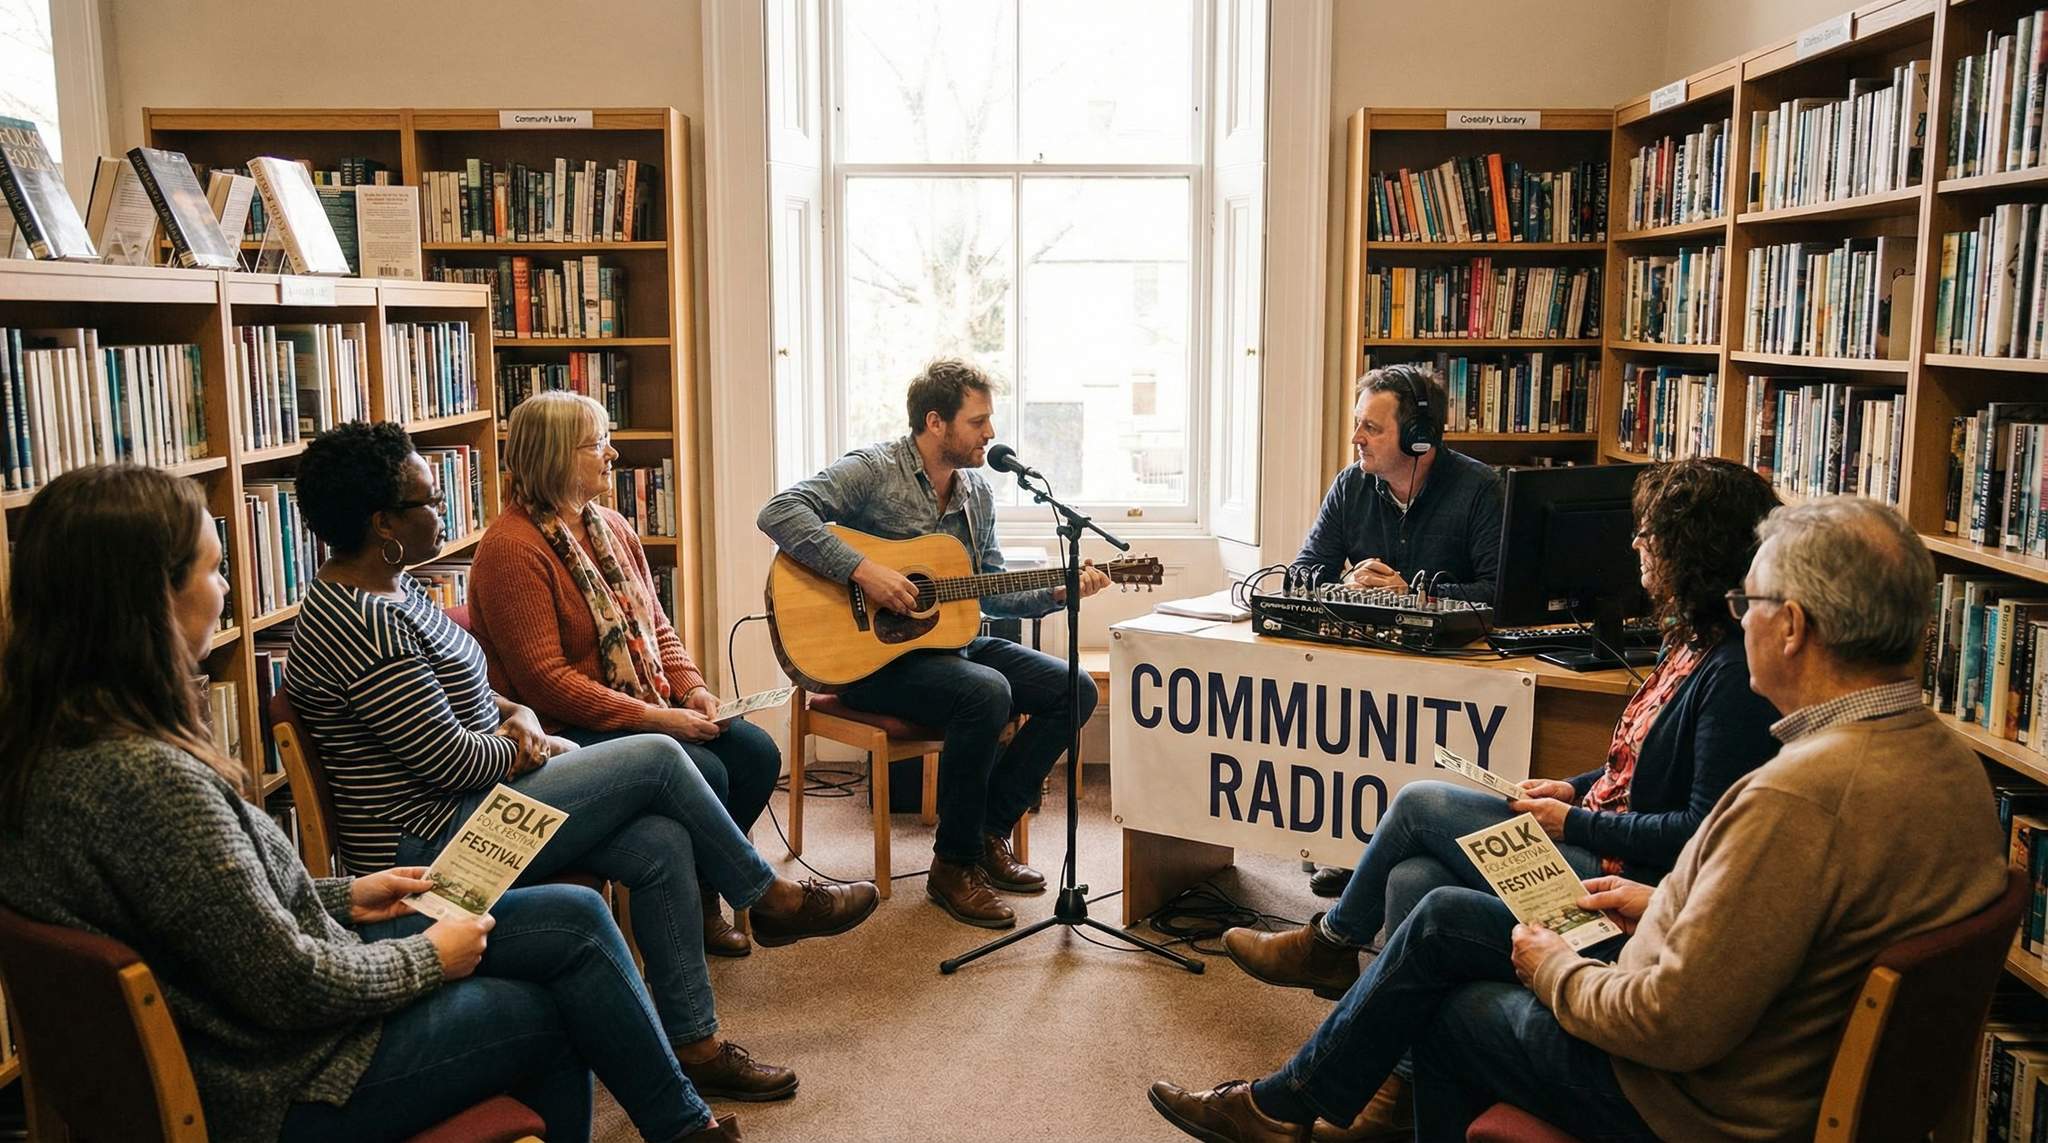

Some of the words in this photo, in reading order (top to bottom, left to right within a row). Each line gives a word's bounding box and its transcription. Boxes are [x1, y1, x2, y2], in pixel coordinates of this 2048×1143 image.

[553, 115, 577, 123] Library
[1496, 115, 1527, 125] Library
[1131, 663, 1508, 773] COMMUNITY
[485, 793, 558, 839] FOLK
[1210, 752, 1388, 844] RADIO
[460, 830, 524, 870] FESTIVAL
[1468, 822, 1543, 863] FOLK
[1497, 861, 1566, 895] FESTIVAL
